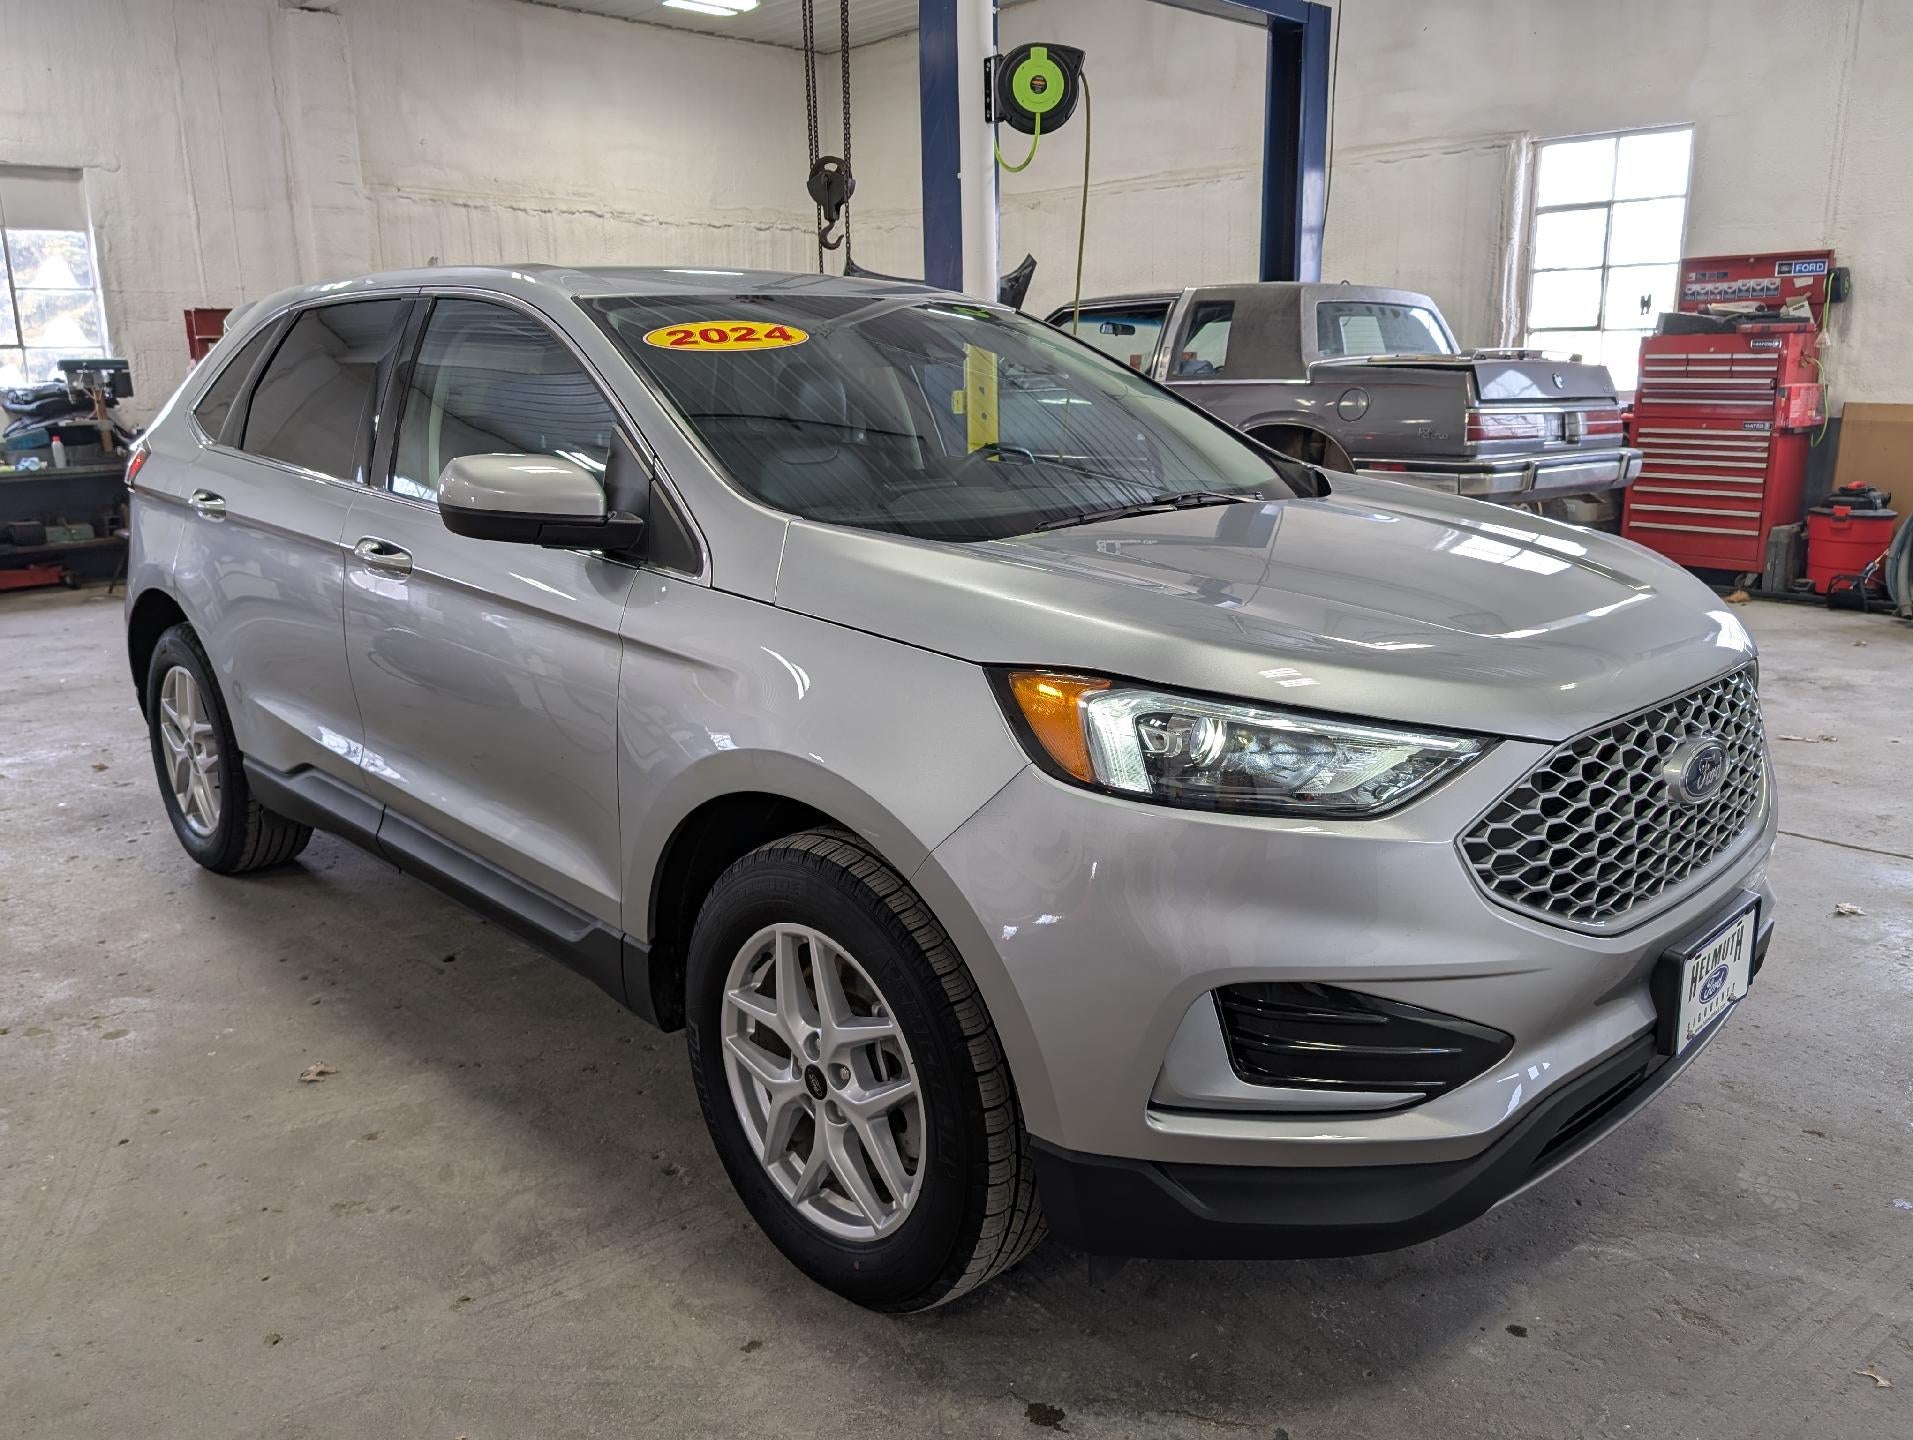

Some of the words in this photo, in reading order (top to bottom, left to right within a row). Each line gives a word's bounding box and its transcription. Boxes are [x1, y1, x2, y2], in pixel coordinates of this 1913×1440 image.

[1795, 262, 1824, 273] FORD
[666, 326, 793, 346] 2024
[1696, 754, 1722, 791] Ford
[1688, 925, 1745, 1002] HELMUTH
[1703, 969, 1725, 999] Ford
